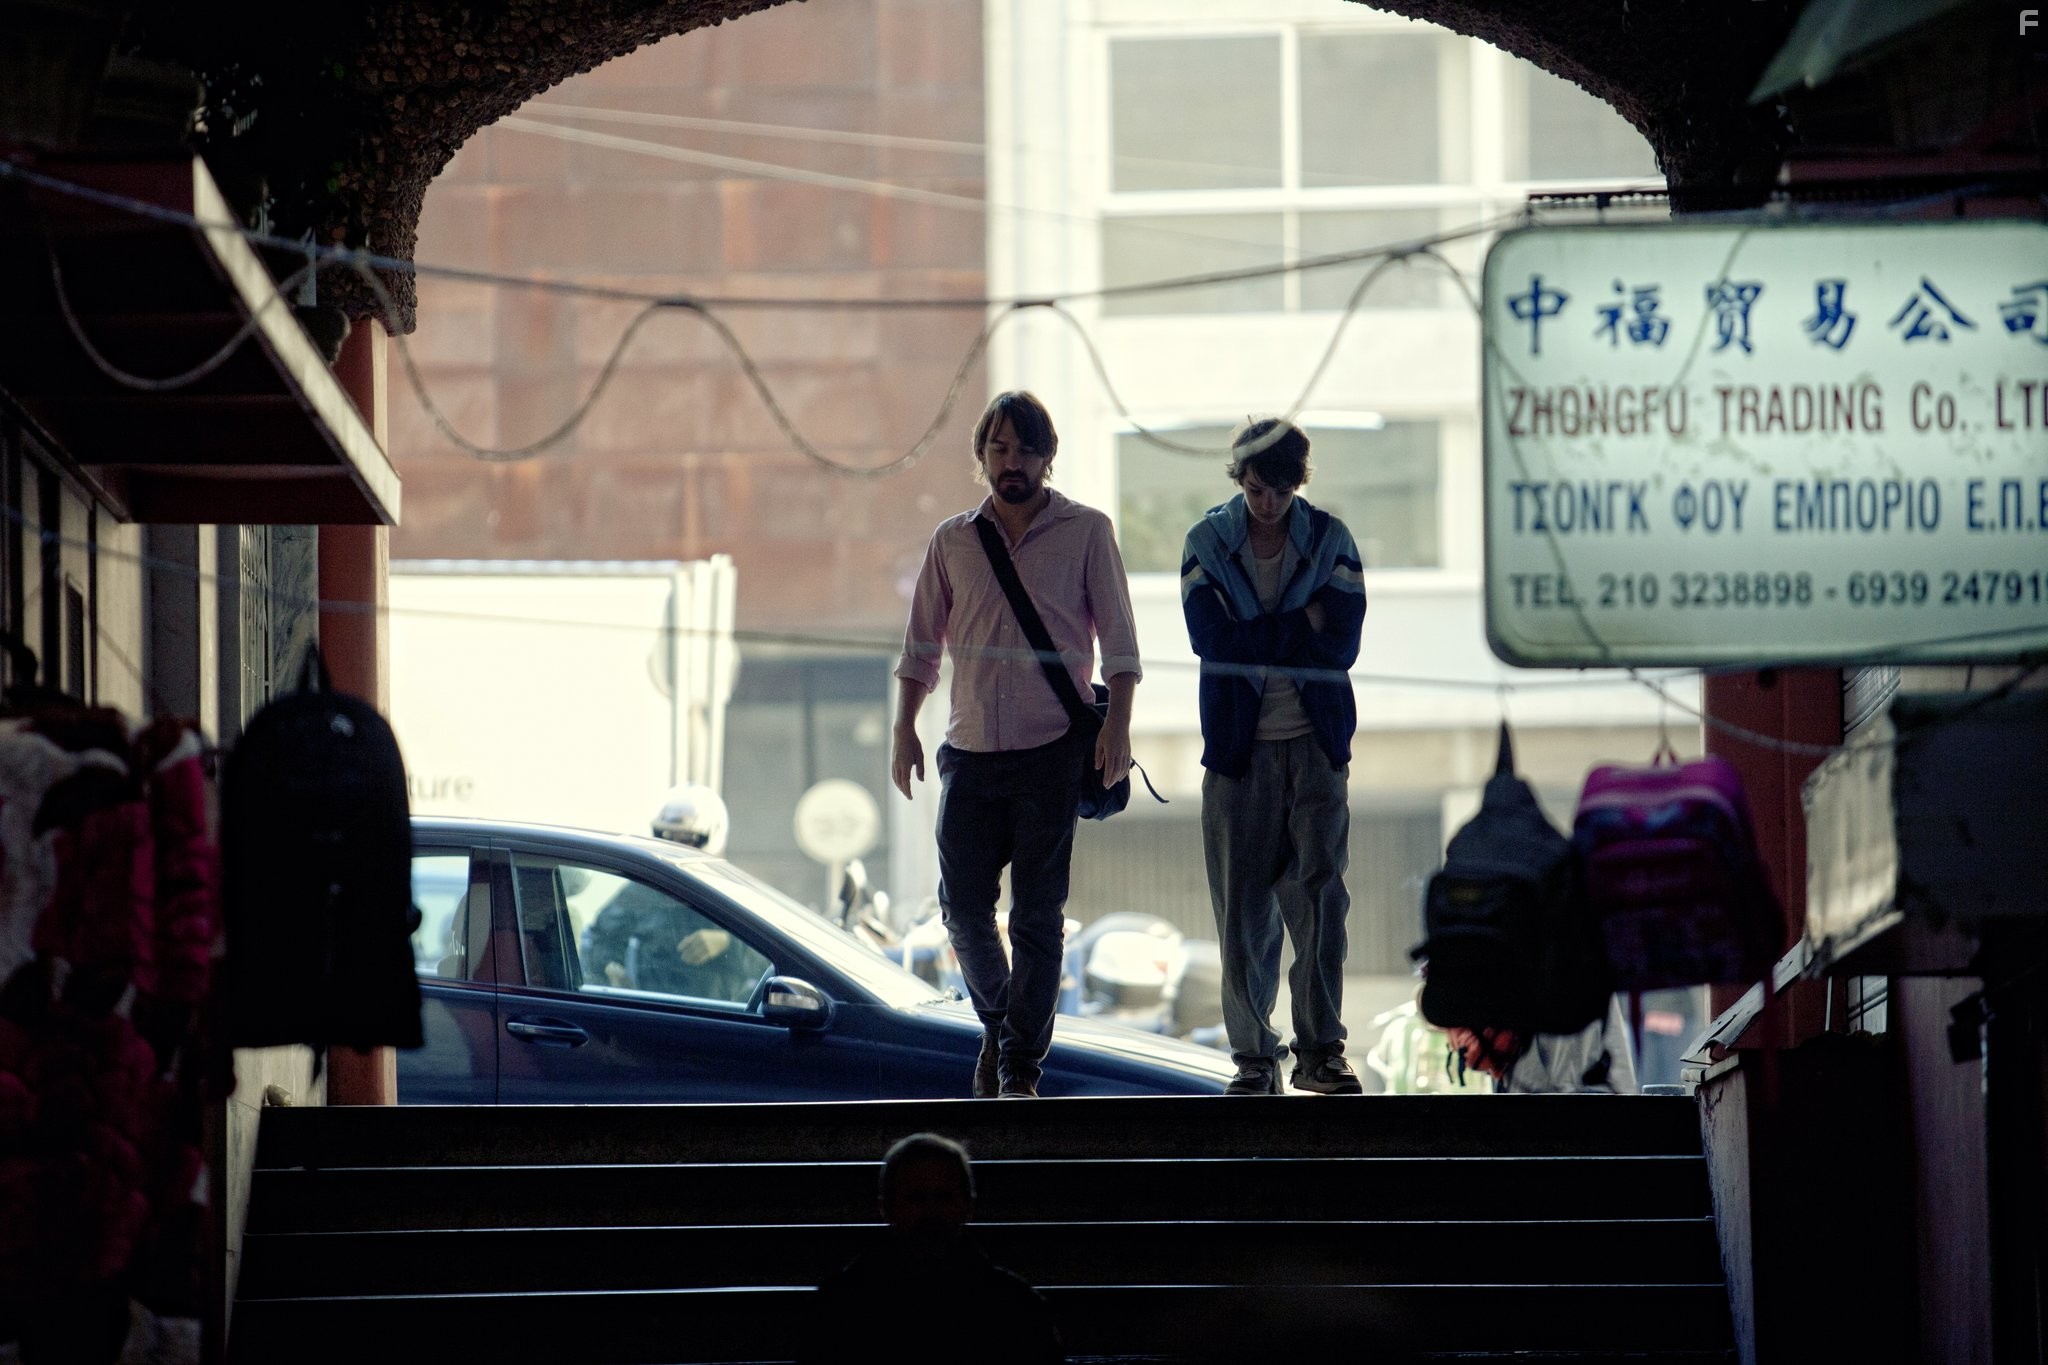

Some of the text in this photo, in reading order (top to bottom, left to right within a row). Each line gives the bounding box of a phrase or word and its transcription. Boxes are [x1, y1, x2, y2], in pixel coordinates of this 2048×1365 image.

[1508, 385, 1688, 437] ZHONGFU
[1715, 382, 1883, 434] TRADING
[1911, 381, 1967, 432] Co.
[1508, 480, 1649, 533] ΤΣΟΝΓΚ
[1673, 478, 1748, 533] ΦΟΥ
[1774, 478, 1941, 532] ΕΜΠΟΡΙΟ
[1598, 572, 1661, 608] 210
[1670, 571, 1813, 608] 3238898
[1848, 570, 1929, 607] 6939
[1941, 569, 2048, 605] 24791
